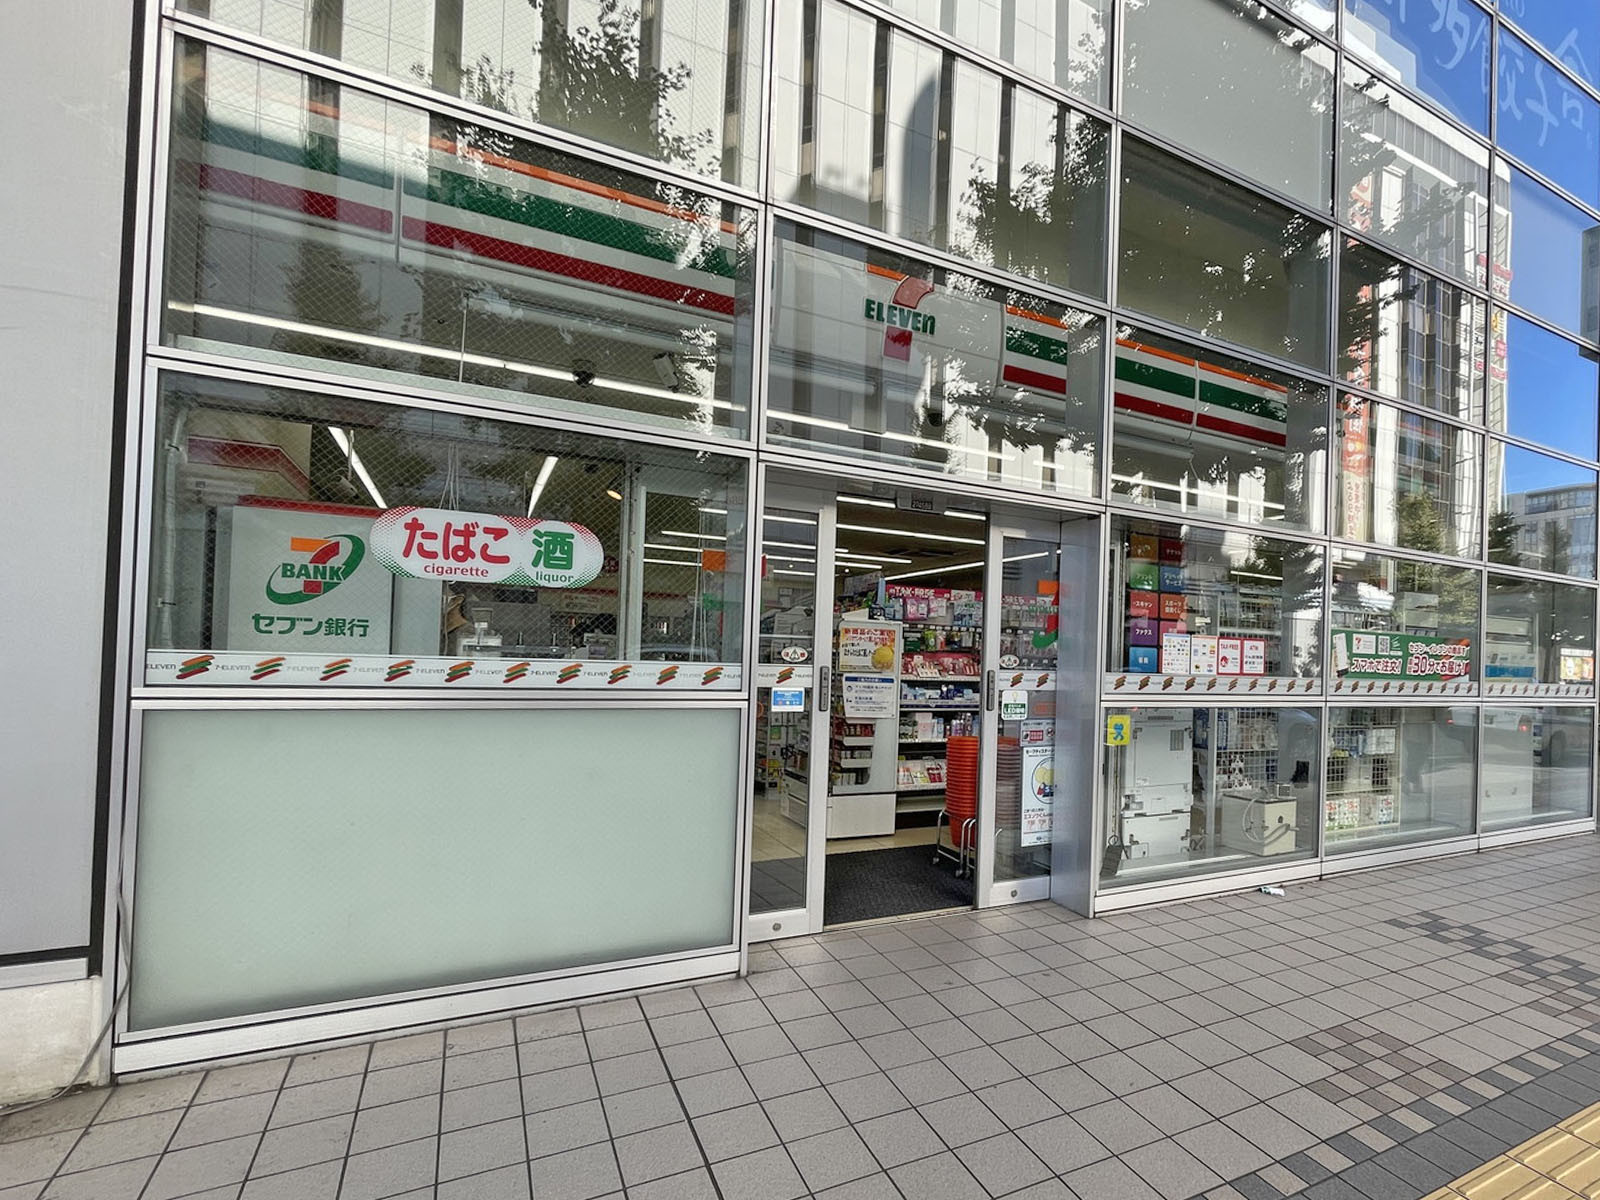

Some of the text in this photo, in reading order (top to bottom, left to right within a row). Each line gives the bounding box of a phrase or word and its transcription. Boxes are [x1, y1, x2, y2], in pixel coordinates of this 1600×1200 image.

[402, 517, 511, 565] たばこ
[531, 528, 575, 571] 酒
[281, 562, 346, 582] BANK
[423, 564, 489, 578] cigarette
[535, 571, 574, 584] liquor
[251, 613, 370, 637] セブン銀行
